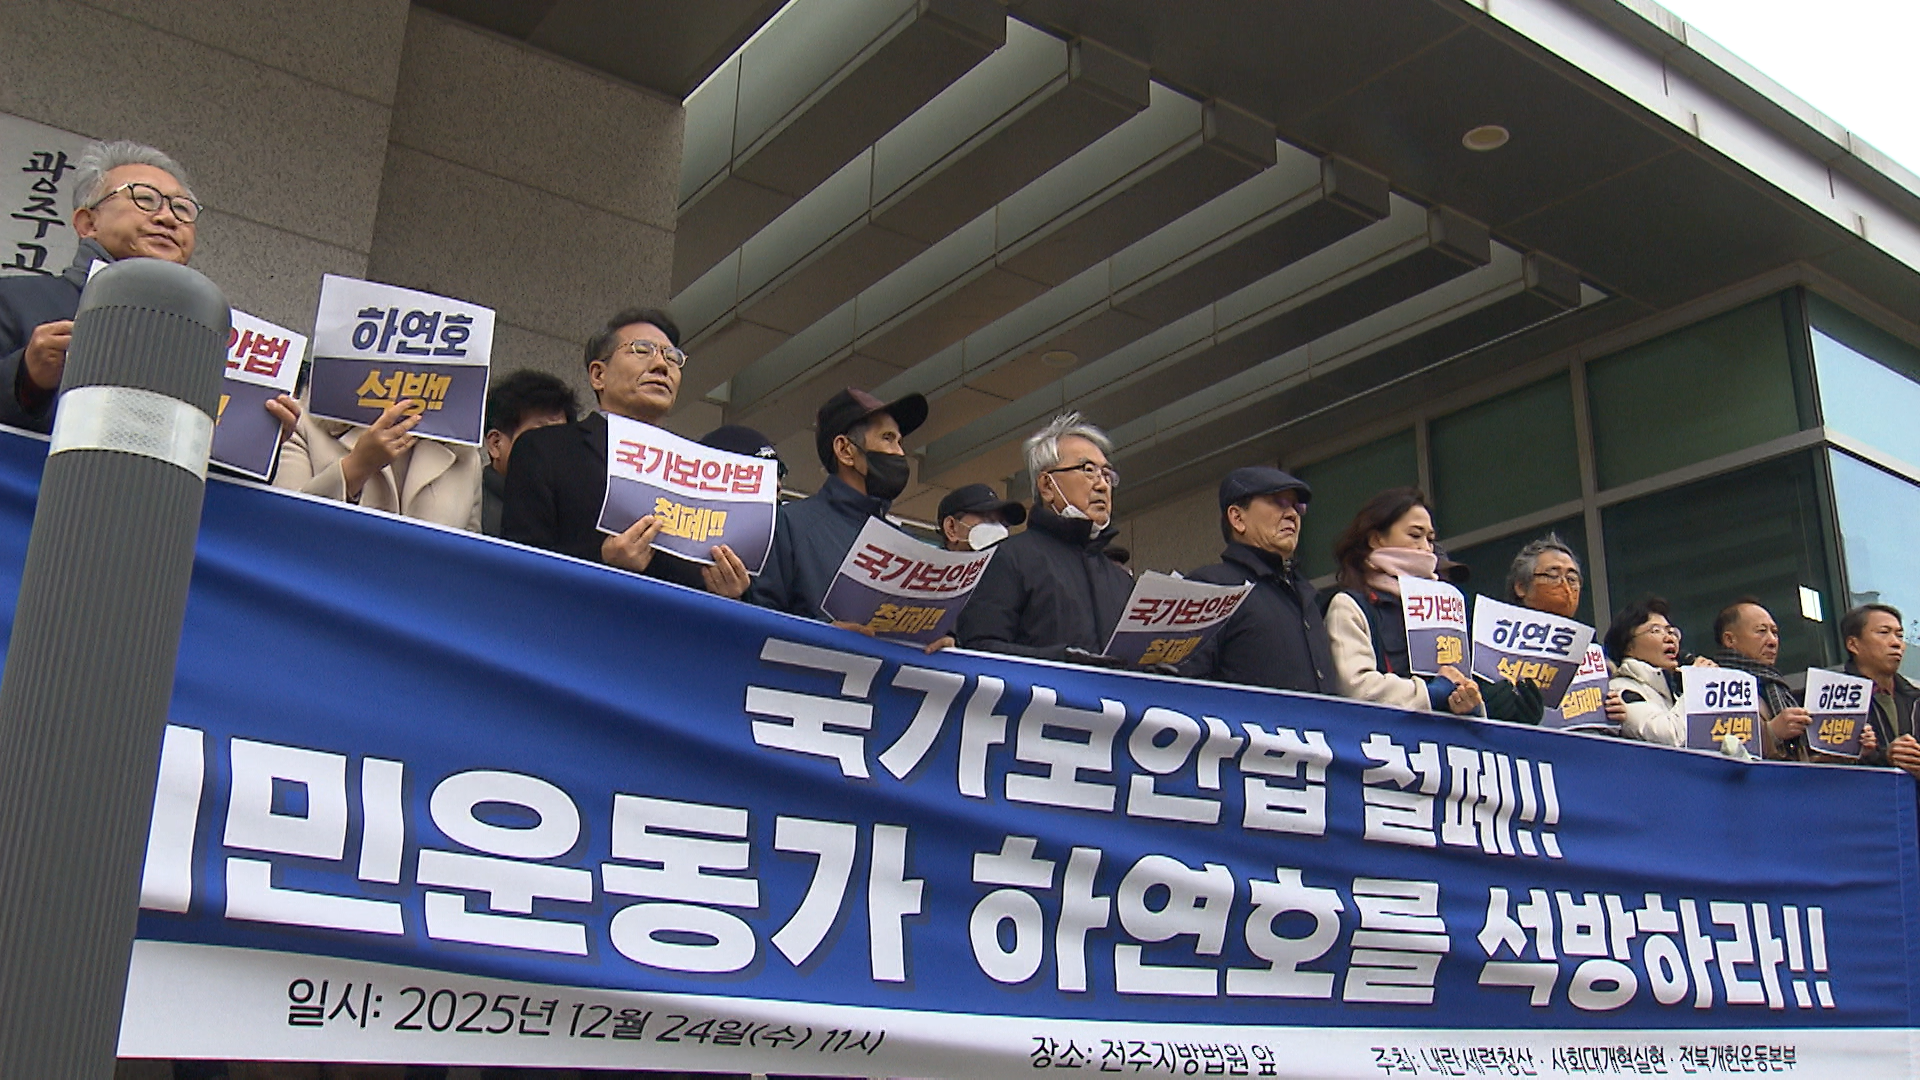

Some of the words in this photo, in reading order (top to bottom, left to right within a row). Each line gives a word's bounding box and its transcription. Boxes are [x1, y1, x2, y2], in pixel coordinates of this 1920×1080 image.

[351, 307, 473, 357] 하연호
[616, 439, 764, 494] 국가보안법
[653, 497, 727, 542] 철폐!!
[853, 543, 990, 592] 국가보안법
[1128, 589, 1247, 626] 국가보안법
[1493, 619, 1577, 656] 하연호
[1705, 680, 1752, 707] 하연호
[1819, 683, 1863, 709] 하연호
[744, 637, 1333, 835] 국가보안법
[1361, 733, 1563, 859] 철폐!!
[968, 837, 1451, 1005] 하연호를
[1477, 887, 1836, 1010] 석방하라!!
[287, 979, 382, 1028] 일시:
[394, 985, 557, 1037] 2025년
[568, 1002, 654, 1041] 12월
[656, 1013, 814, 1048] 24일(수)
[819, 1029, 887, 1056] 11시
[1031, 1036, 1093, 1069] 장소:
[1099, 1039, 1249, 1076] 전주지방법원
[1252, 1043, 1278, 1077] 앞
[1370, 1047, 1420, 1076] 주최:
[1552, 1045, 1669, 1075] 사회대개혁실현
[1678, 1044, 1797, 1074] 전북개헌운동본부
